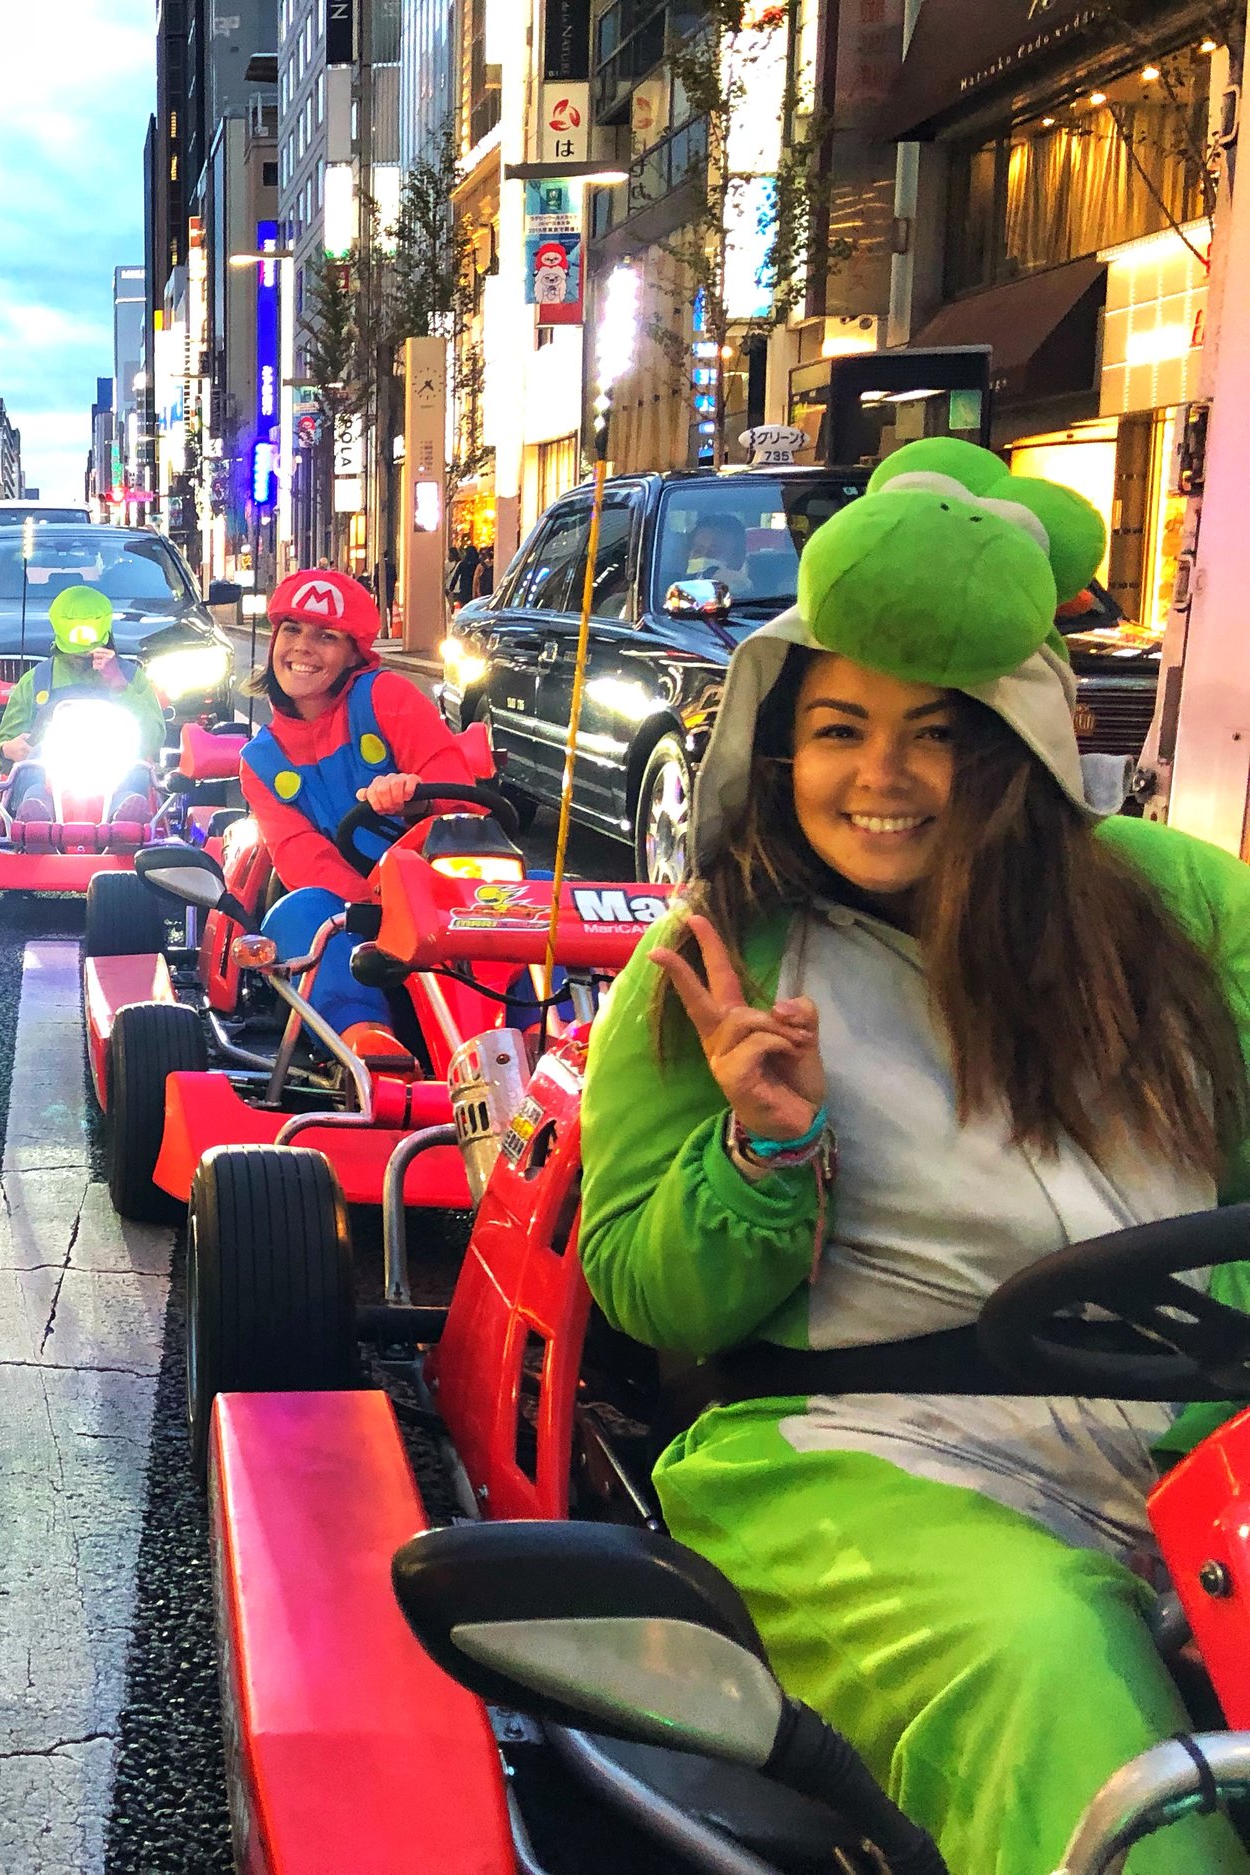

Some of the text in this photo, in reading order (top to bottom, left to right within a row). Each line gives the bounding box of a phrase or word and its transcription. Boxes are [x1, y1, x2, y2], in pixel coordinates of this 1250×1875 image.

[555, 139, 575, 158] は
[757, 431, 800, 446] グリーン
[764, 451, 790, 462] 735
[295, 585, 338, 616] M
